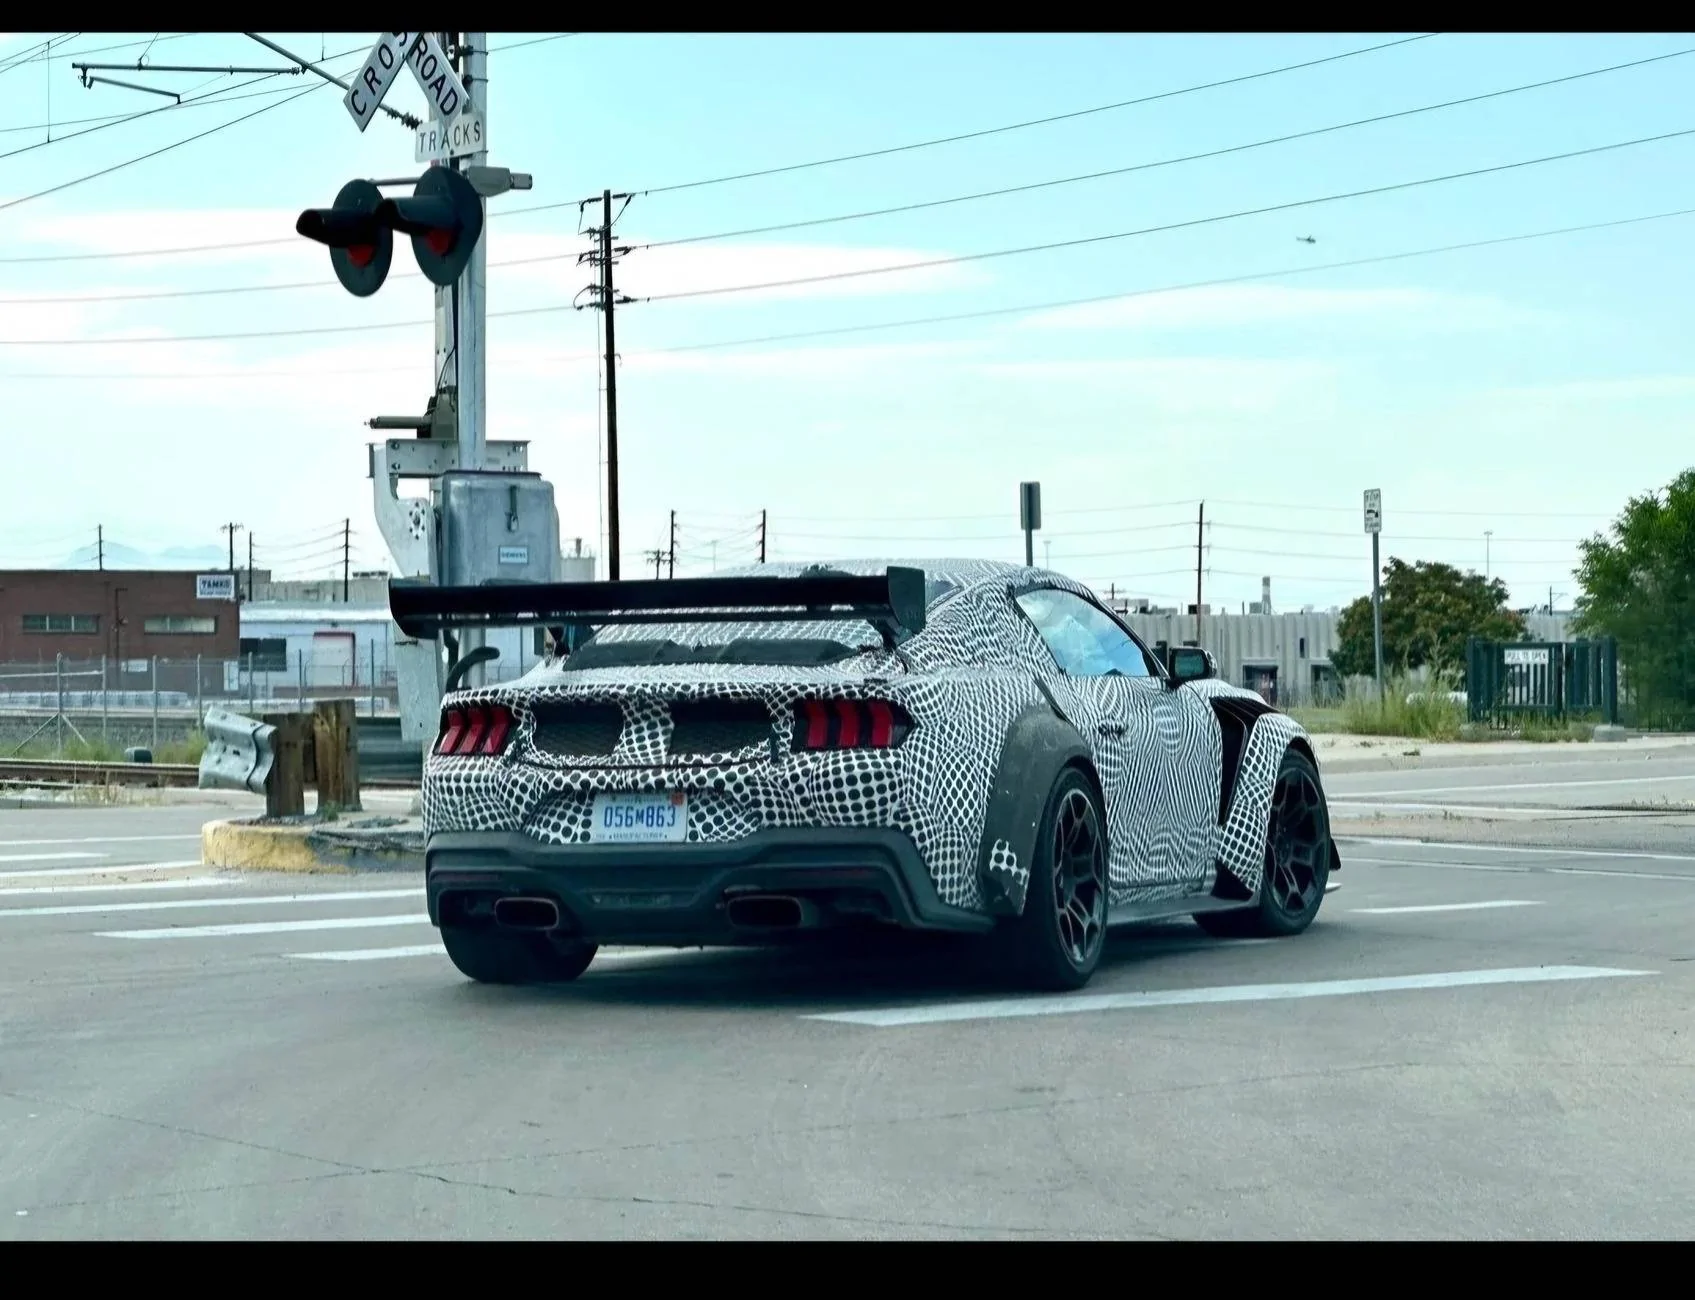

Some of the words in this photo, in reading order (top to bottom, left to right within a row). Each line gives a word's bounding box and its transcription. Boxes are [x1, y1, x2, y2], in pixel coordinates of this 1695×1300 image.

[410, 31, 458, 116] ROAD
[420, 120, 481, 153] TRACKS
[604, 805, 676, 828] 056M863
